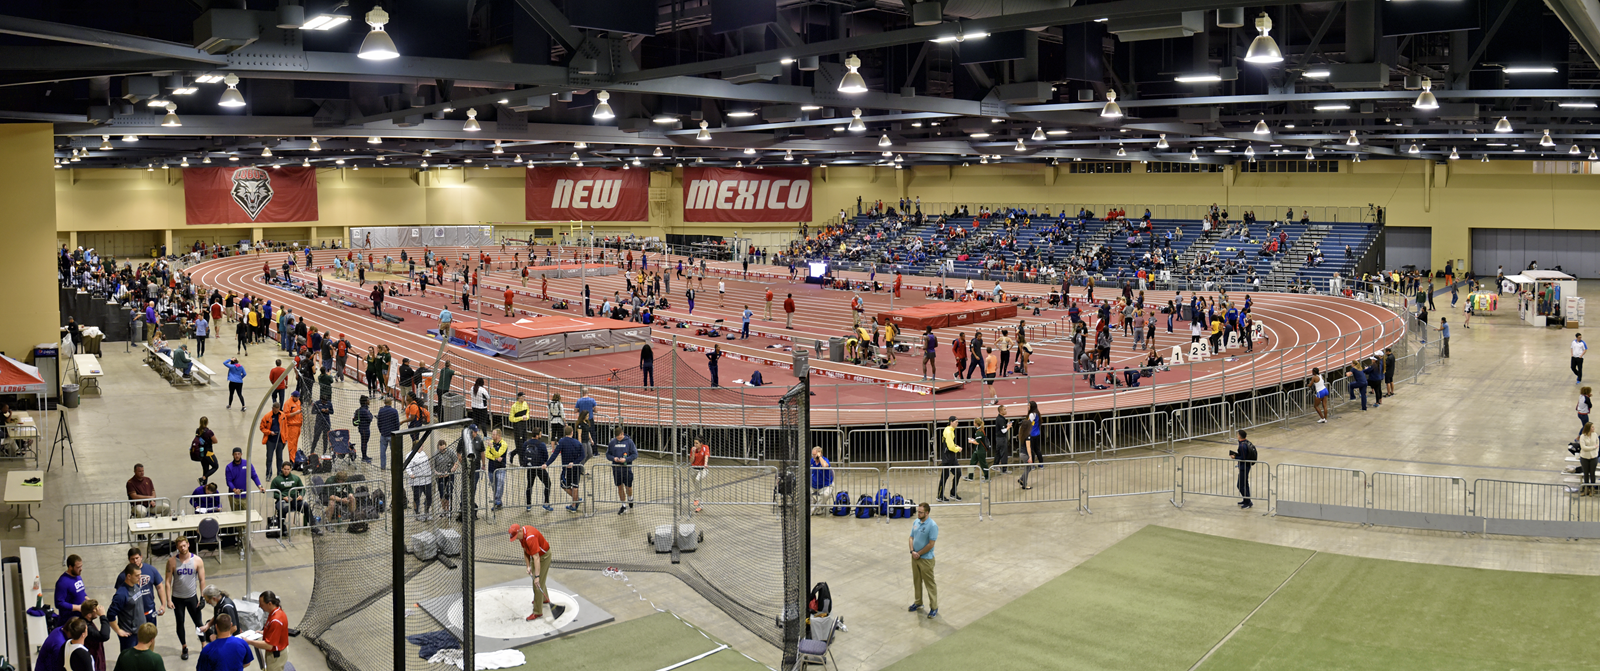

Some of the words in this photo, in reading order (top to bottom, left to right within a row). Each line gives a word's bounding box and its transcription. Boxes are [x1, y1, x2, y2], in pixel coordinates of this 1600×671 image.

[235, 169, 268, 179] LOBOS
[551, 179, 623, 208] NEW
[685, 179, 810, 210] MEXICO
[1256, 324, 1262, 332] 8
[1230, 335, 1236, 343] 5
[1192, 347, 1199, 356] 2
[1200, 343, 1207, 352] 3
[1174, 352, 1180, 361] 1
[3, 385, 27, 393] LOBOS
[176, 568, 194, 576] GCU
